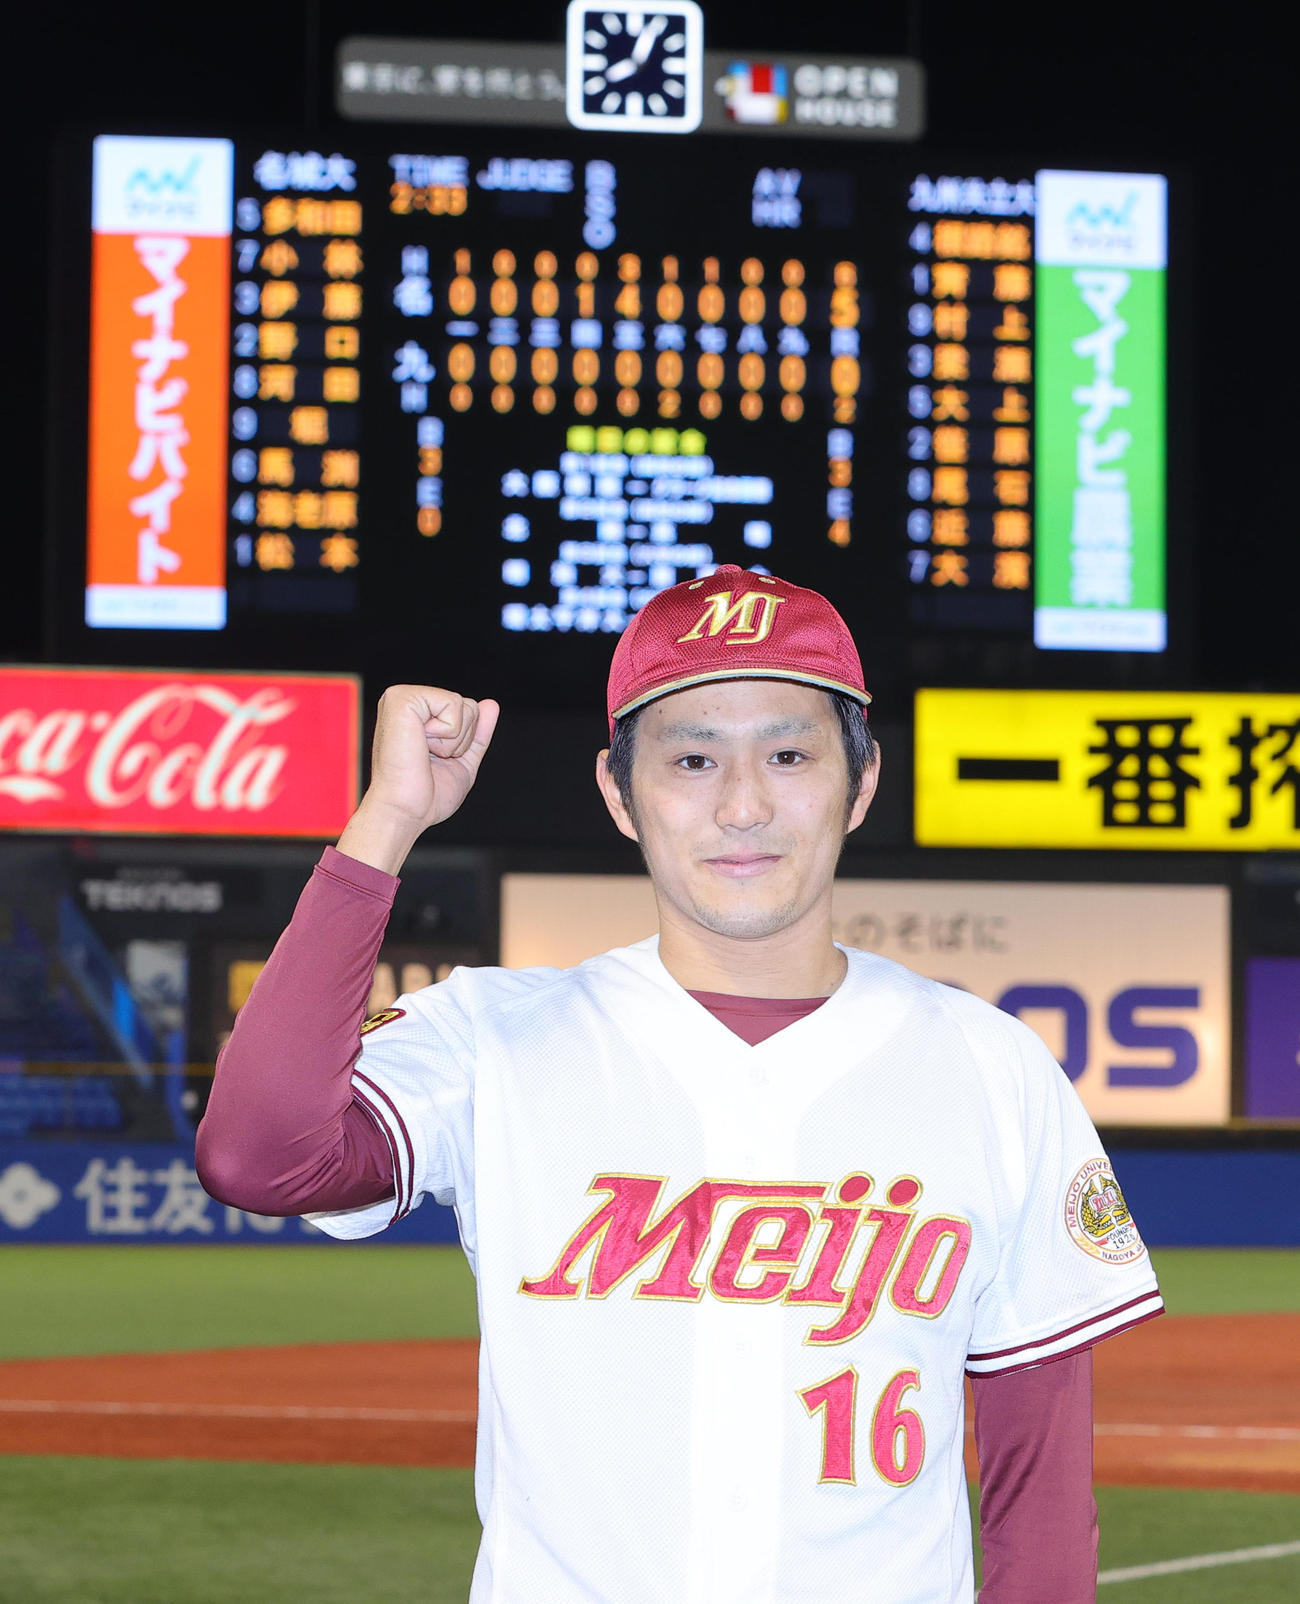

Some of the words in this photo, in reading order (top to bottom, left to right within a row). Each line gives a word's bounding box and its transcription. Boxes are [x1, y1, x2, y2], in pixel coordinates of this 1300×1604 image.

[794, 64, 899, 99] OPEN
[795, 98, 898, 128] HOUSE
[128, 237, 191, 585] マイナビバイト
[676, 591, 786, 645] MJ
[1067, 1181, 1081, 1228] MEIJO
[517, 1170, 971, 1347] Meijo
[1102, 1250, 1136, 1262] NAGOYA
[796, 1364, 926, 1487] 16
